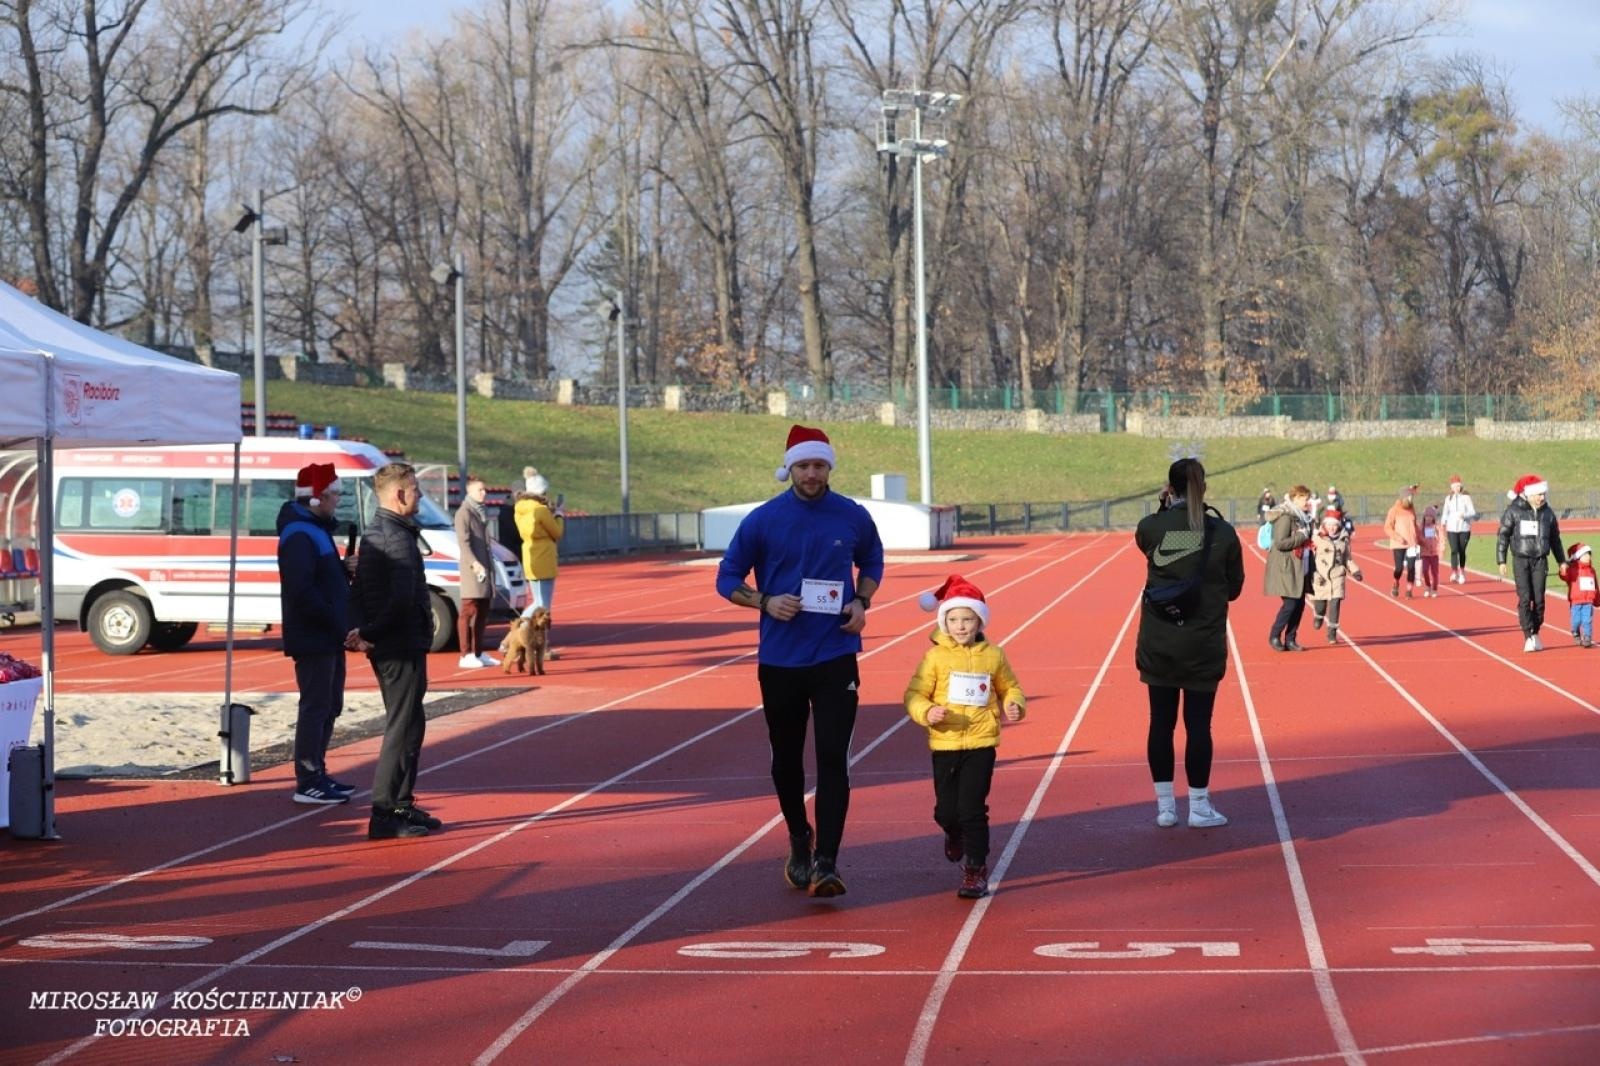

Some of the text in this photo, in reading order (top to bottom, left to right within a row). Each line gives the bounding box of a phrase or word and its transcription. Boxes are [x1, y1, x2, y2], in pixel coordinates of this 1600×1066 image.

[83, 382, 120, 401] Racibórz
[816, 595, 827, 603] 55
[965, 688, 976, 697] 58
[349, 940, 551, 957] 7
[677, 941, 886, 958] 6
[1033, 942, 1240, 958] 5
[1391, 938, 1594, 955] 4
